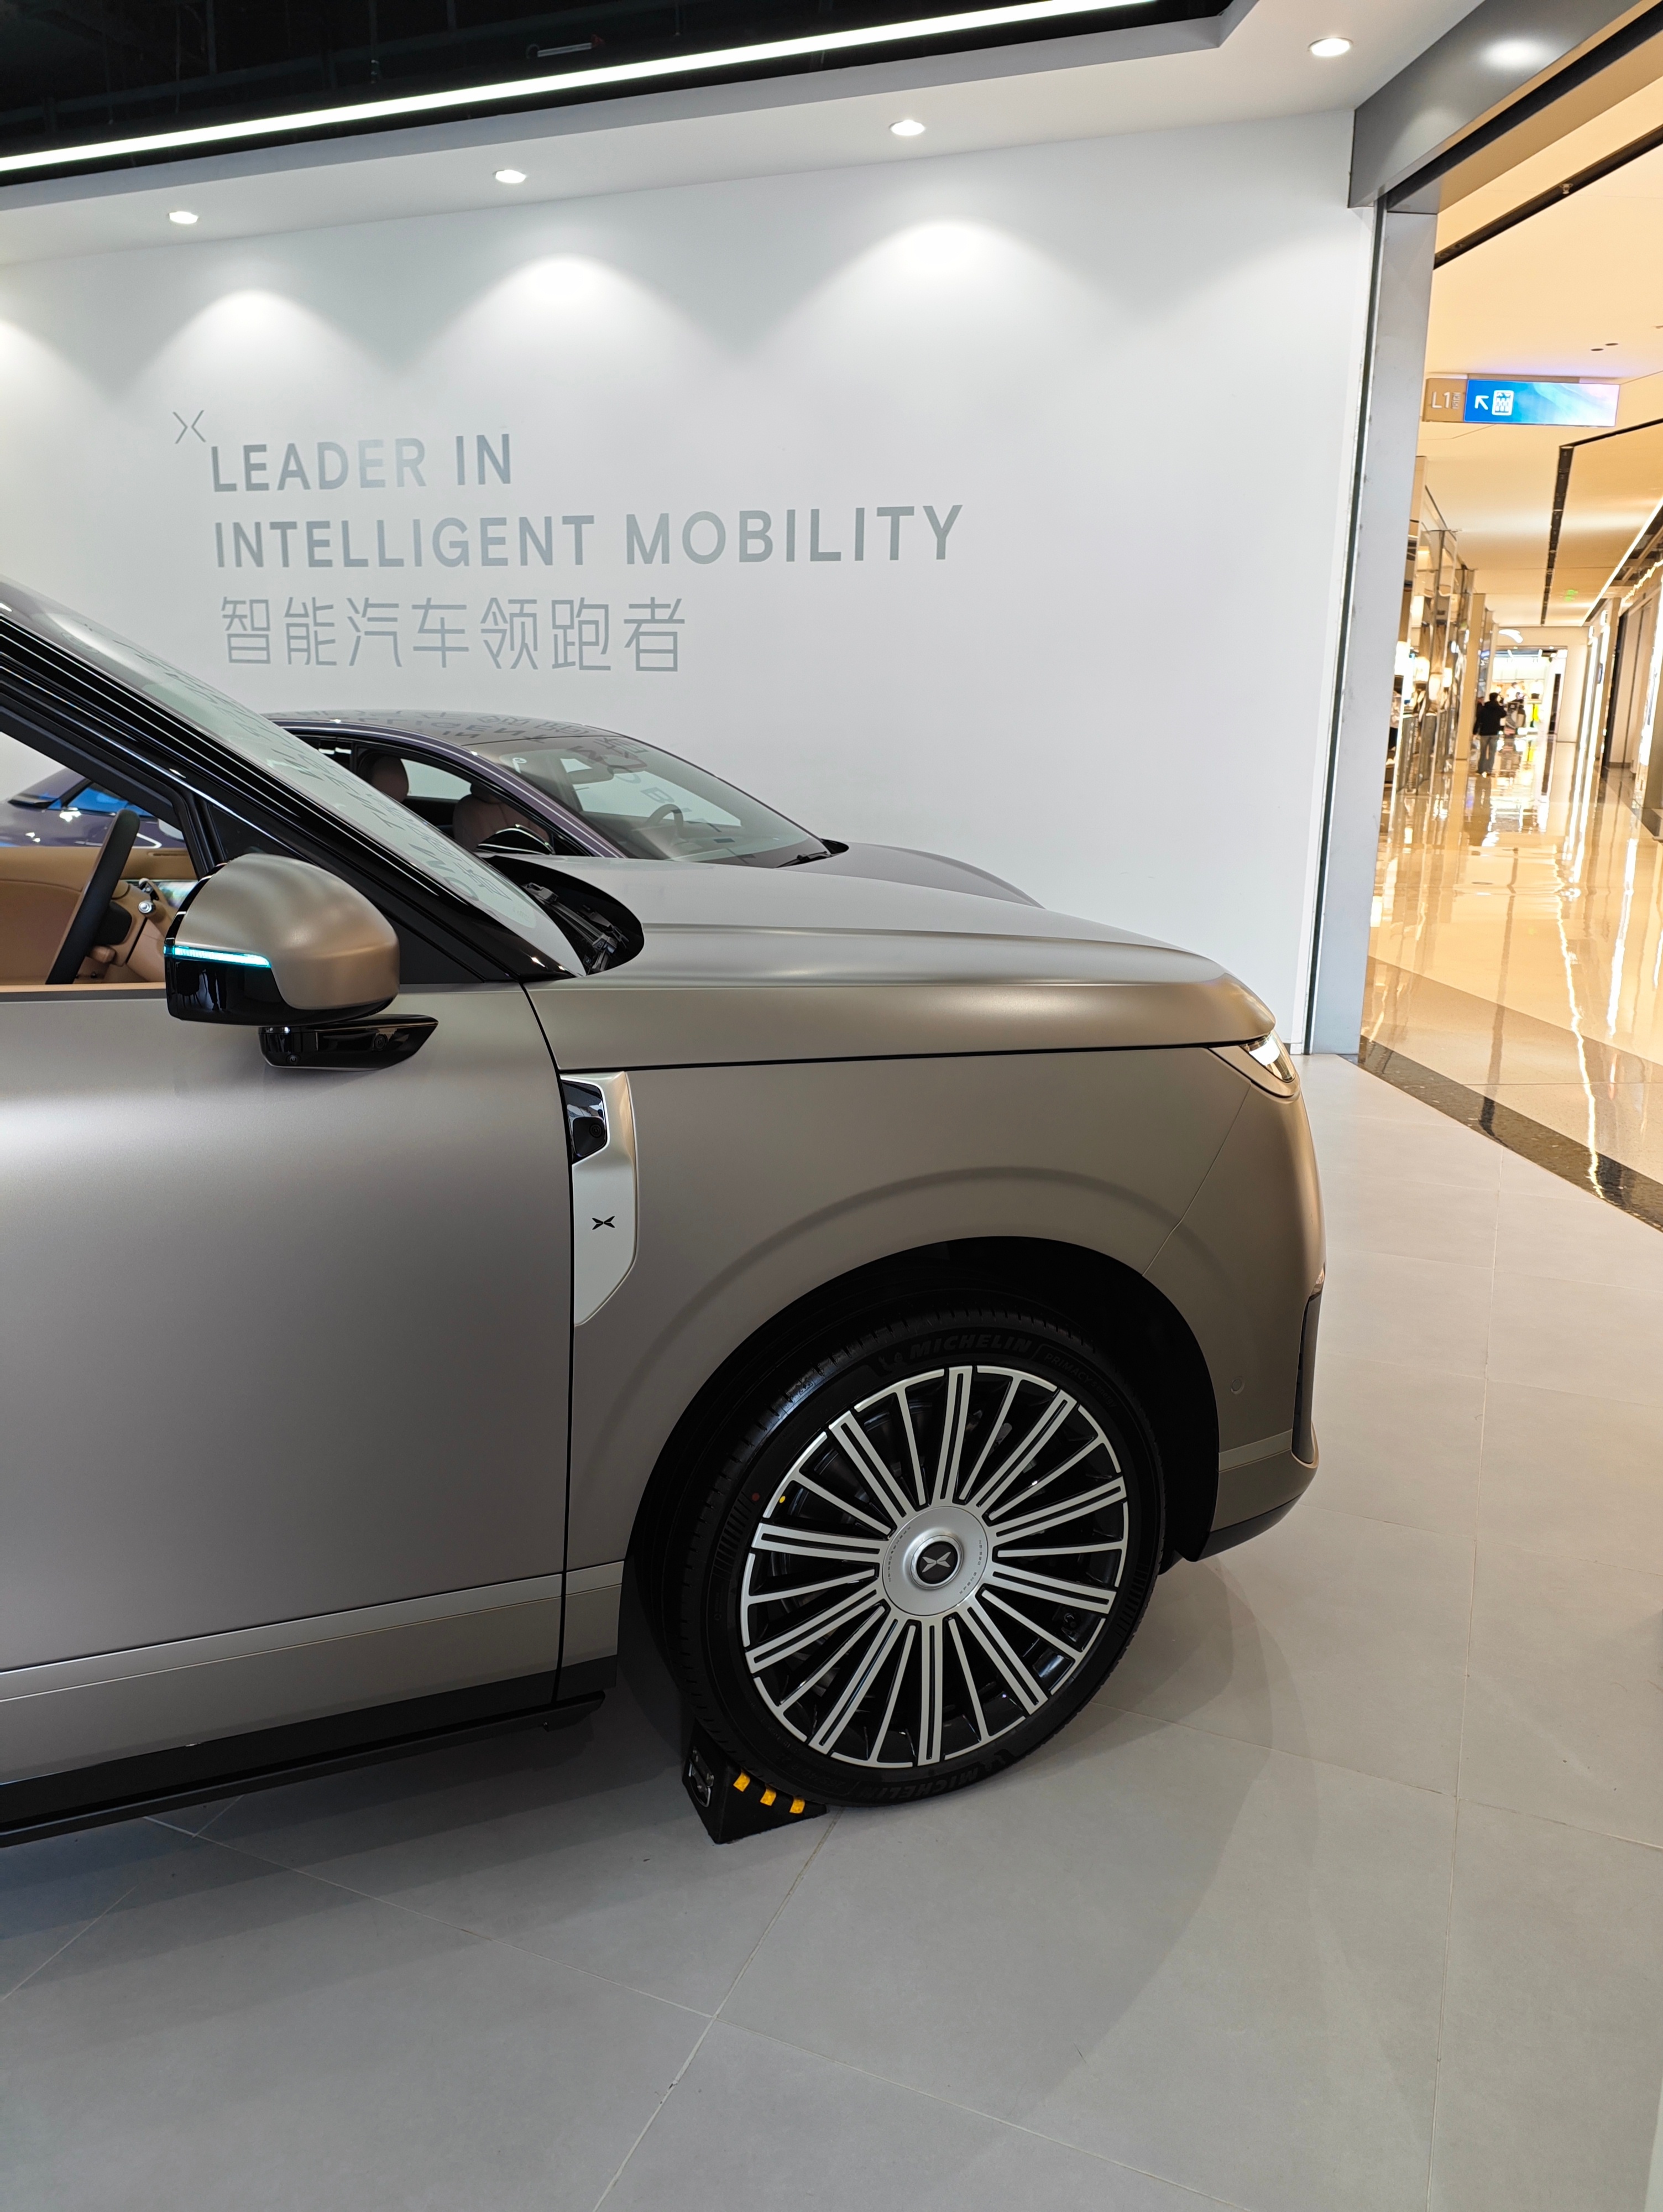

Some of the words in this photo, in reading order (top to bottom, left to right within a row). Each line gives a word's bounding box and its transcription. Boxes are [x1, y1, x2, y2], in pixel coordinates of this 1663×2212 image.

[1431, 392, 1450, 408] L1
[211, 438, 427, 492] LEADER
[455, 434, 511, 486] IN
[215, 515, 594, 568] INTELLIGENT
[626, 504, 963, 565] MOBILITY
[221, 596, 685, 672] 智能汽车领跑者
[909, 1333, 1032, 1360] MICHELIN
[860, 1767, 979, 1799] MICHELIN
